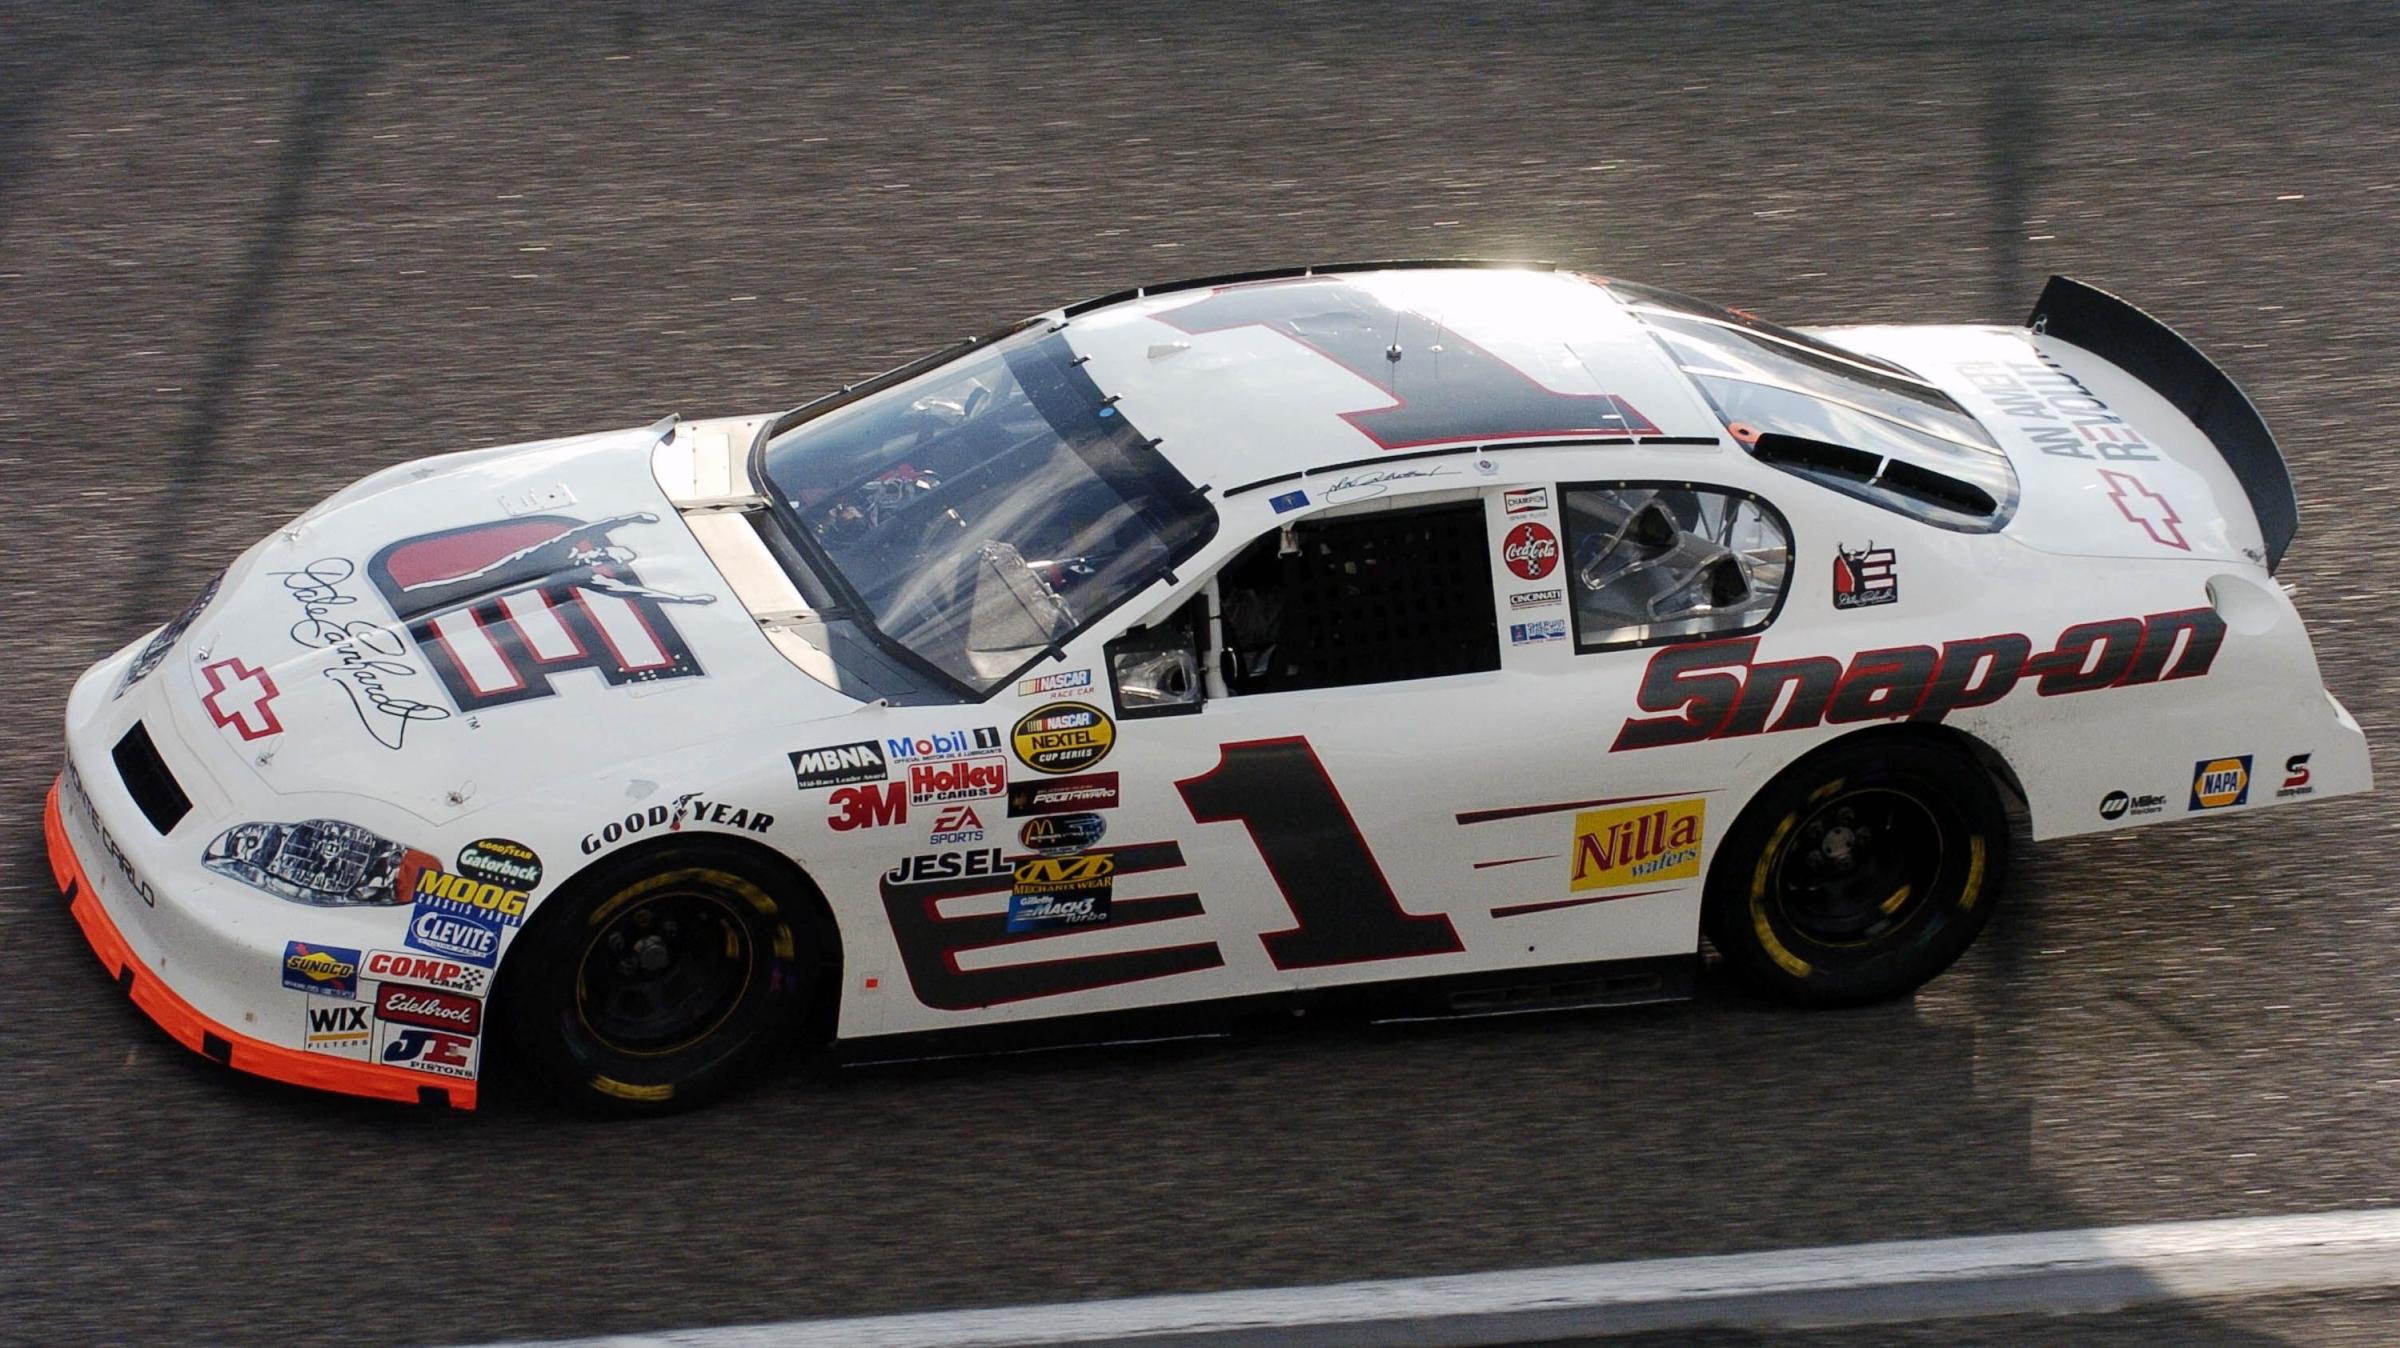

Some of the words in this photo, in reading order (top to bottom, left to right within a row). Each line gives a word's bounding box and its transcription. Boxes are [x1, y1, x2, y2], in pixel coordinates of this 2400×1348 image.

[1147, 274, 1664, 450] 1
[2021, 426, 2097, 461] AN
[1511, 589, 1561, 604] CINCINNATI
[1040, 670, 1088, 693] NASCAR
[1050, 691, 1074, 700] RACE
[1077, 687, 1095, 695] CAR
[1609, 607, 2227, 752] Snap-on
[1047, 712, 1090, 730] NASCAR
[887, 731, 967, 758] Mobil
[1032, 731, 1096, 750] NEXTEL
[798, 745, 883, 775] MBNA
[1039, 753, 1059, 763] CUP
[1060, 749, 1093, 760] SERIES
[911, 762, 1004, 795] Holley
[2203, 771, 2239, 795] NAPA
[828, 781, 907, 832] 3M
[912, 792, 934, 804] HP
[936, 787, 989, 801] CARBS
[932, 806, 983, 834] EA
[929, 830, 984, 845] SPORTS
[1572, 810, 1699, 881] Nilla
[460, 849, 539, 882] Gatorback
[888, 848, 1013, 883] JESEL
[1174, 735, 1466, 971] 1
[1632, 849, 1697, 877] wafers
[101, 826, 155, 909] CARLO
[416, 869, 529, 916] MOOG
[1014, 880, 1076, 895] MECHANIX
[1077, 876, 1113, 889] WEAR
[418, 892, 473, 916] CHASSIS
[479, 908, 519, 926] PARTS
[1033, 897, 1096, 917] MACH3
[1066, 911, 1108, 923] Turbo
[416, 911, 494, 952] CLEVITE
[288, 956, 353, 977] SUNOCO
[369, 953, 462, 983] COMP
[430, 978, 475, 992] CAMS
[309, 1005, 369, 1033] WIX
[386, 992, 472, 1024] Edelbrock
[308, 1039, 369, 1050] FILTERS
[384, 1029, 473, 1068] JE
[409, 1060, 474, 1078] PISTONS
